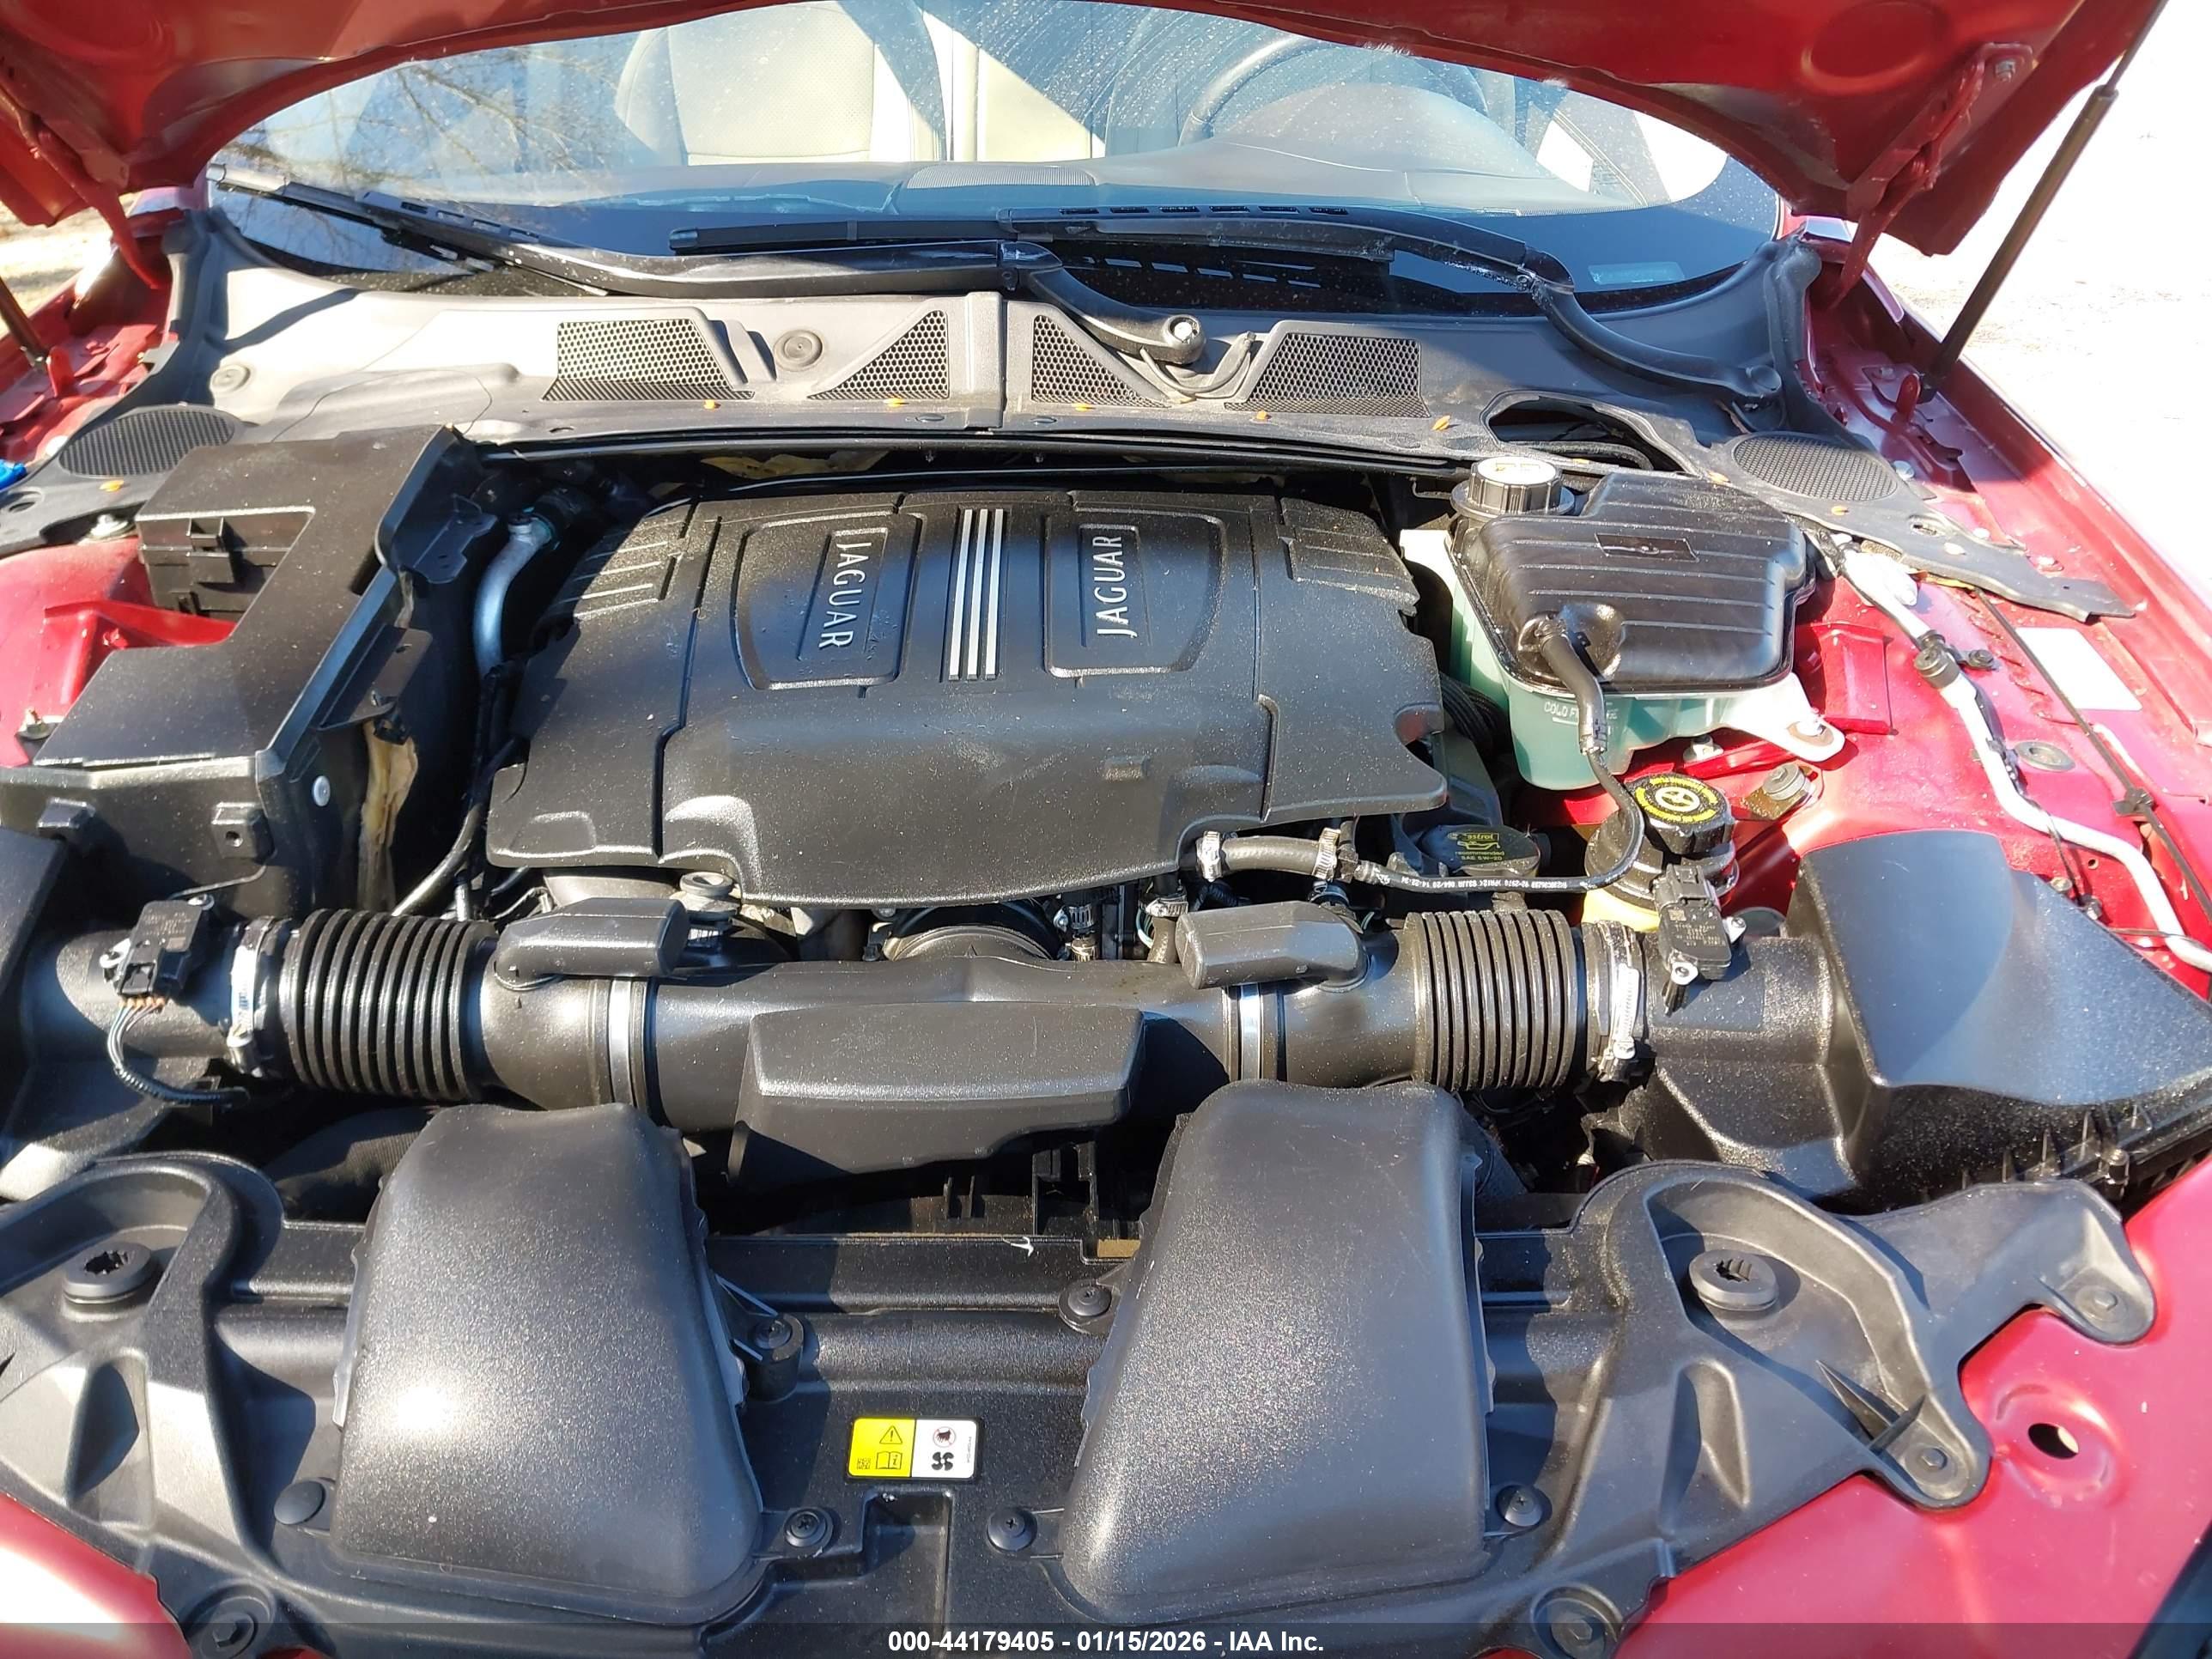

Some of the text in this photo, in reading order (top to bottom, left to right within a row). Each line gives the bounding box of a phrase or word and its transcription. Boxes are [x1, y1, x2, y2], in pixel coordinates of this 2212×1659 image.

[818, 542, 872, 649] JAGUAR
[1092, 536, 1138, 639] JAGUAR
[1544, 702, 1569, 718] COLD
